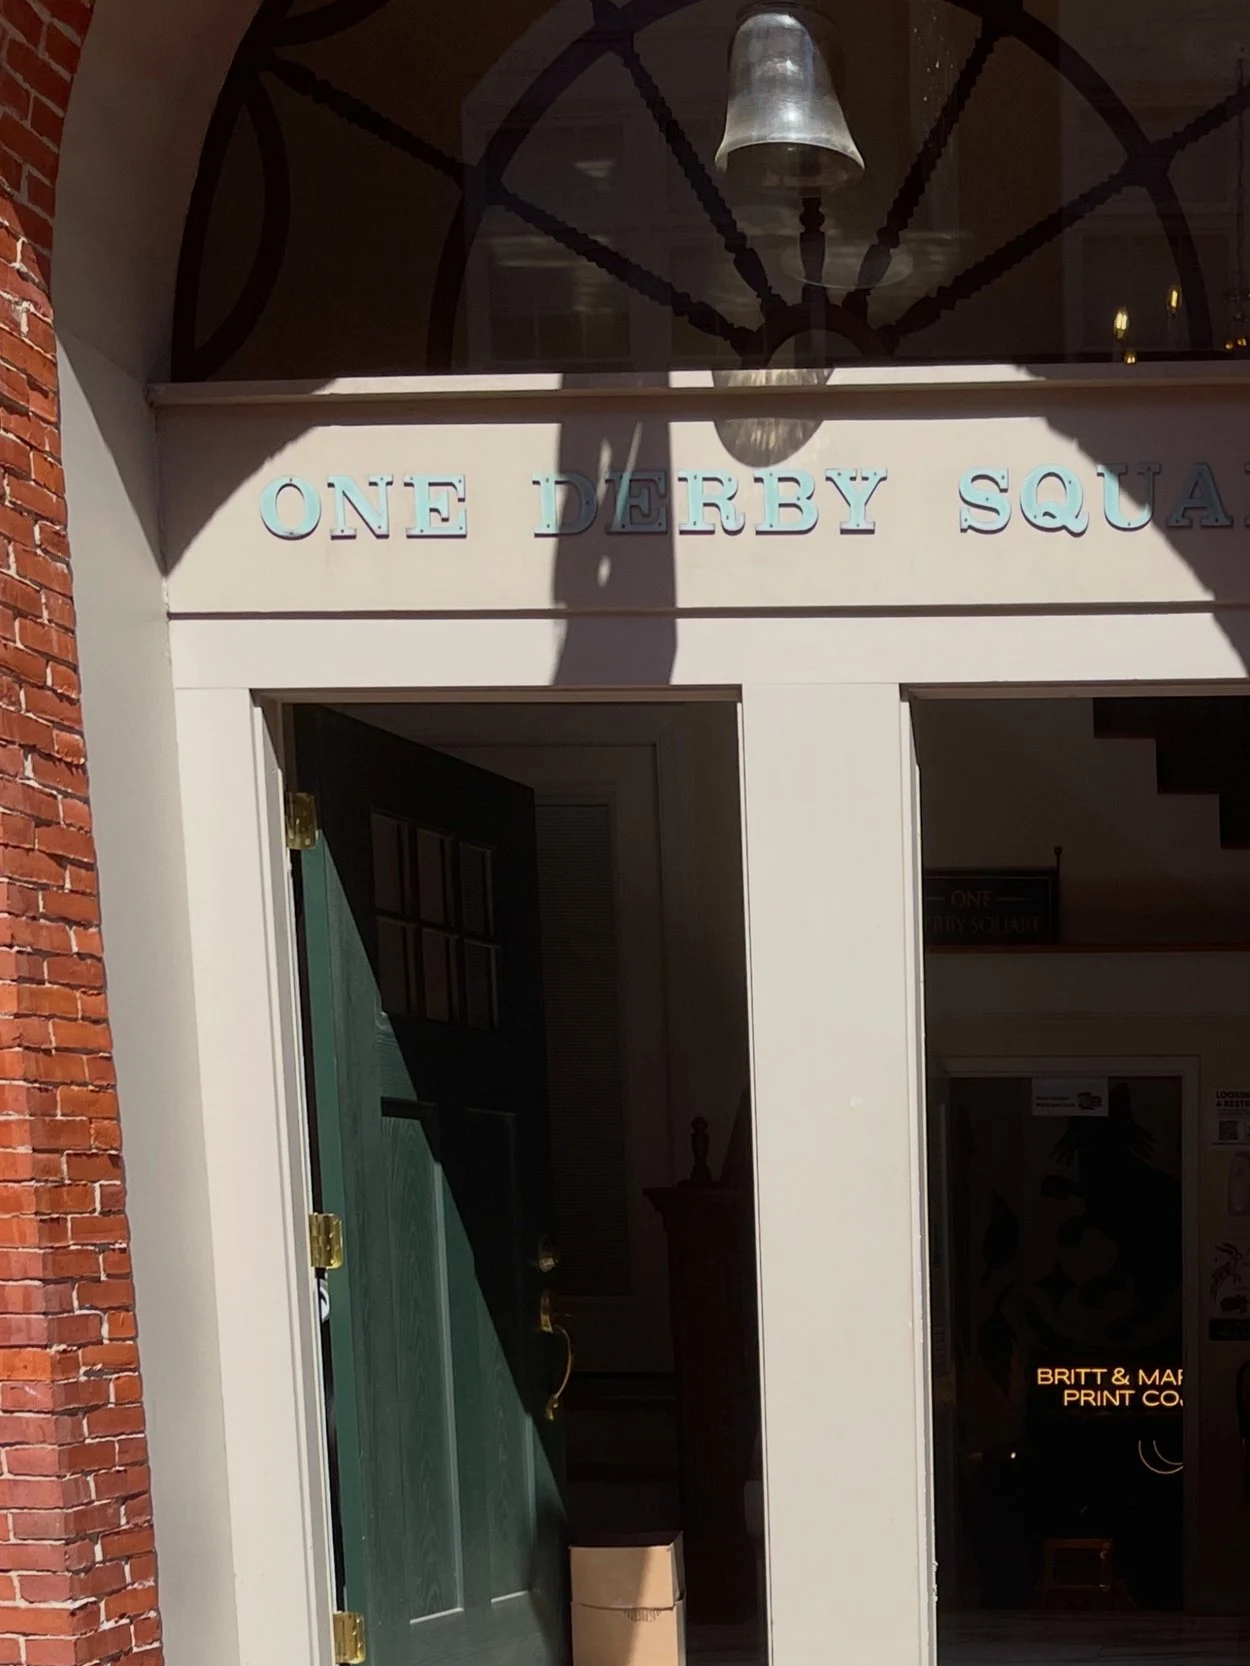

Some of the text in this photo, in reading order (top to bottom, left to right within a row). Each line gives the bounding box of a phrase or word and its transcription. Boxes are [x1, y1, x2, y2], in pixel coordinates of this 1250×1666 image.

[260, 474, 468, 540] ONE
[532, 467, 887, 539] DERBY
[950, 889, 993, 908] ONE
[1037, 1367, 1108, 1386] BRITT
[1111, 1366, 1131, 1386] &
[1063, 1389, 1136, 1407] PRINT
